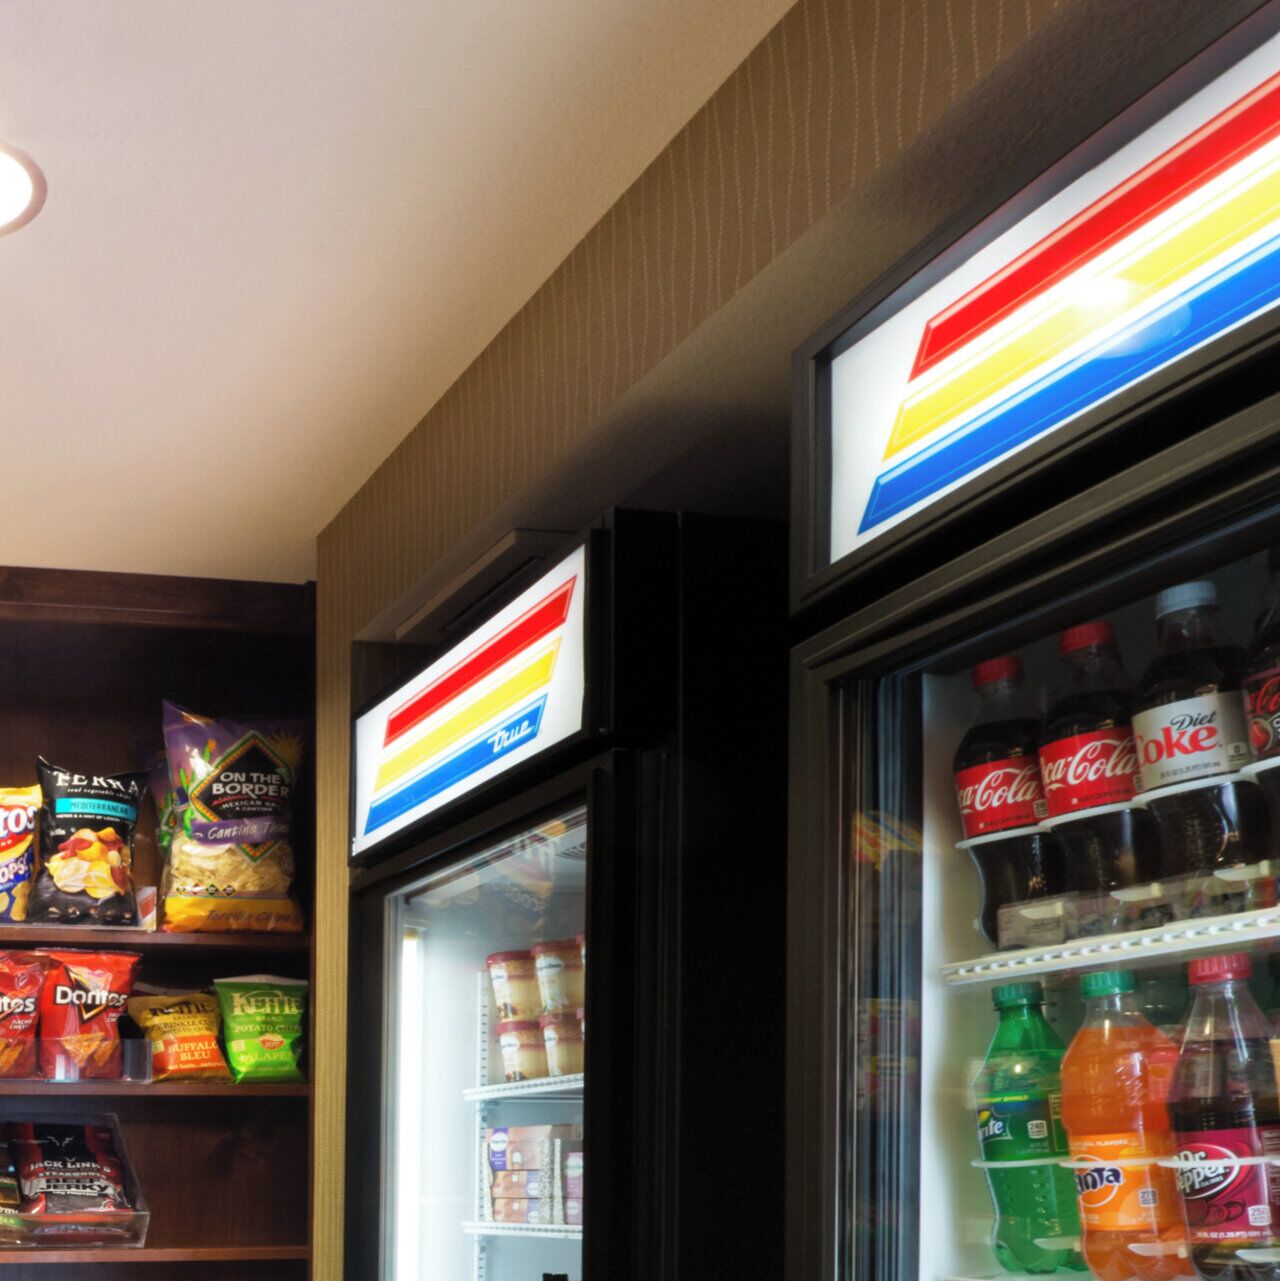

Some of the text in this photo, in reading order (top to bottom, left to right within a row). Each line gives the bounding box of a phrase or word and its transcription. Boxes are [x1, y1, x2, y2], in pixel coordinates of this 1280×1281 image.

[1170, 711, 1217, 731] Diet
[220, 771, 281, 785] ON THE
[212, 783, 290, 799] BORDER
[70, 801, 129, 815] MEDITERRANEAN
[207, 824, 257, 840] Cantina
[55, 986, 128, 1006] Doritos
[234, 1024, 274, 1032] POTATO
[180, 1051, 211, 1061] BLEU
[30, 1160, 64, 1171] JACK
[40, 1183, 110, 1192] JERKY
